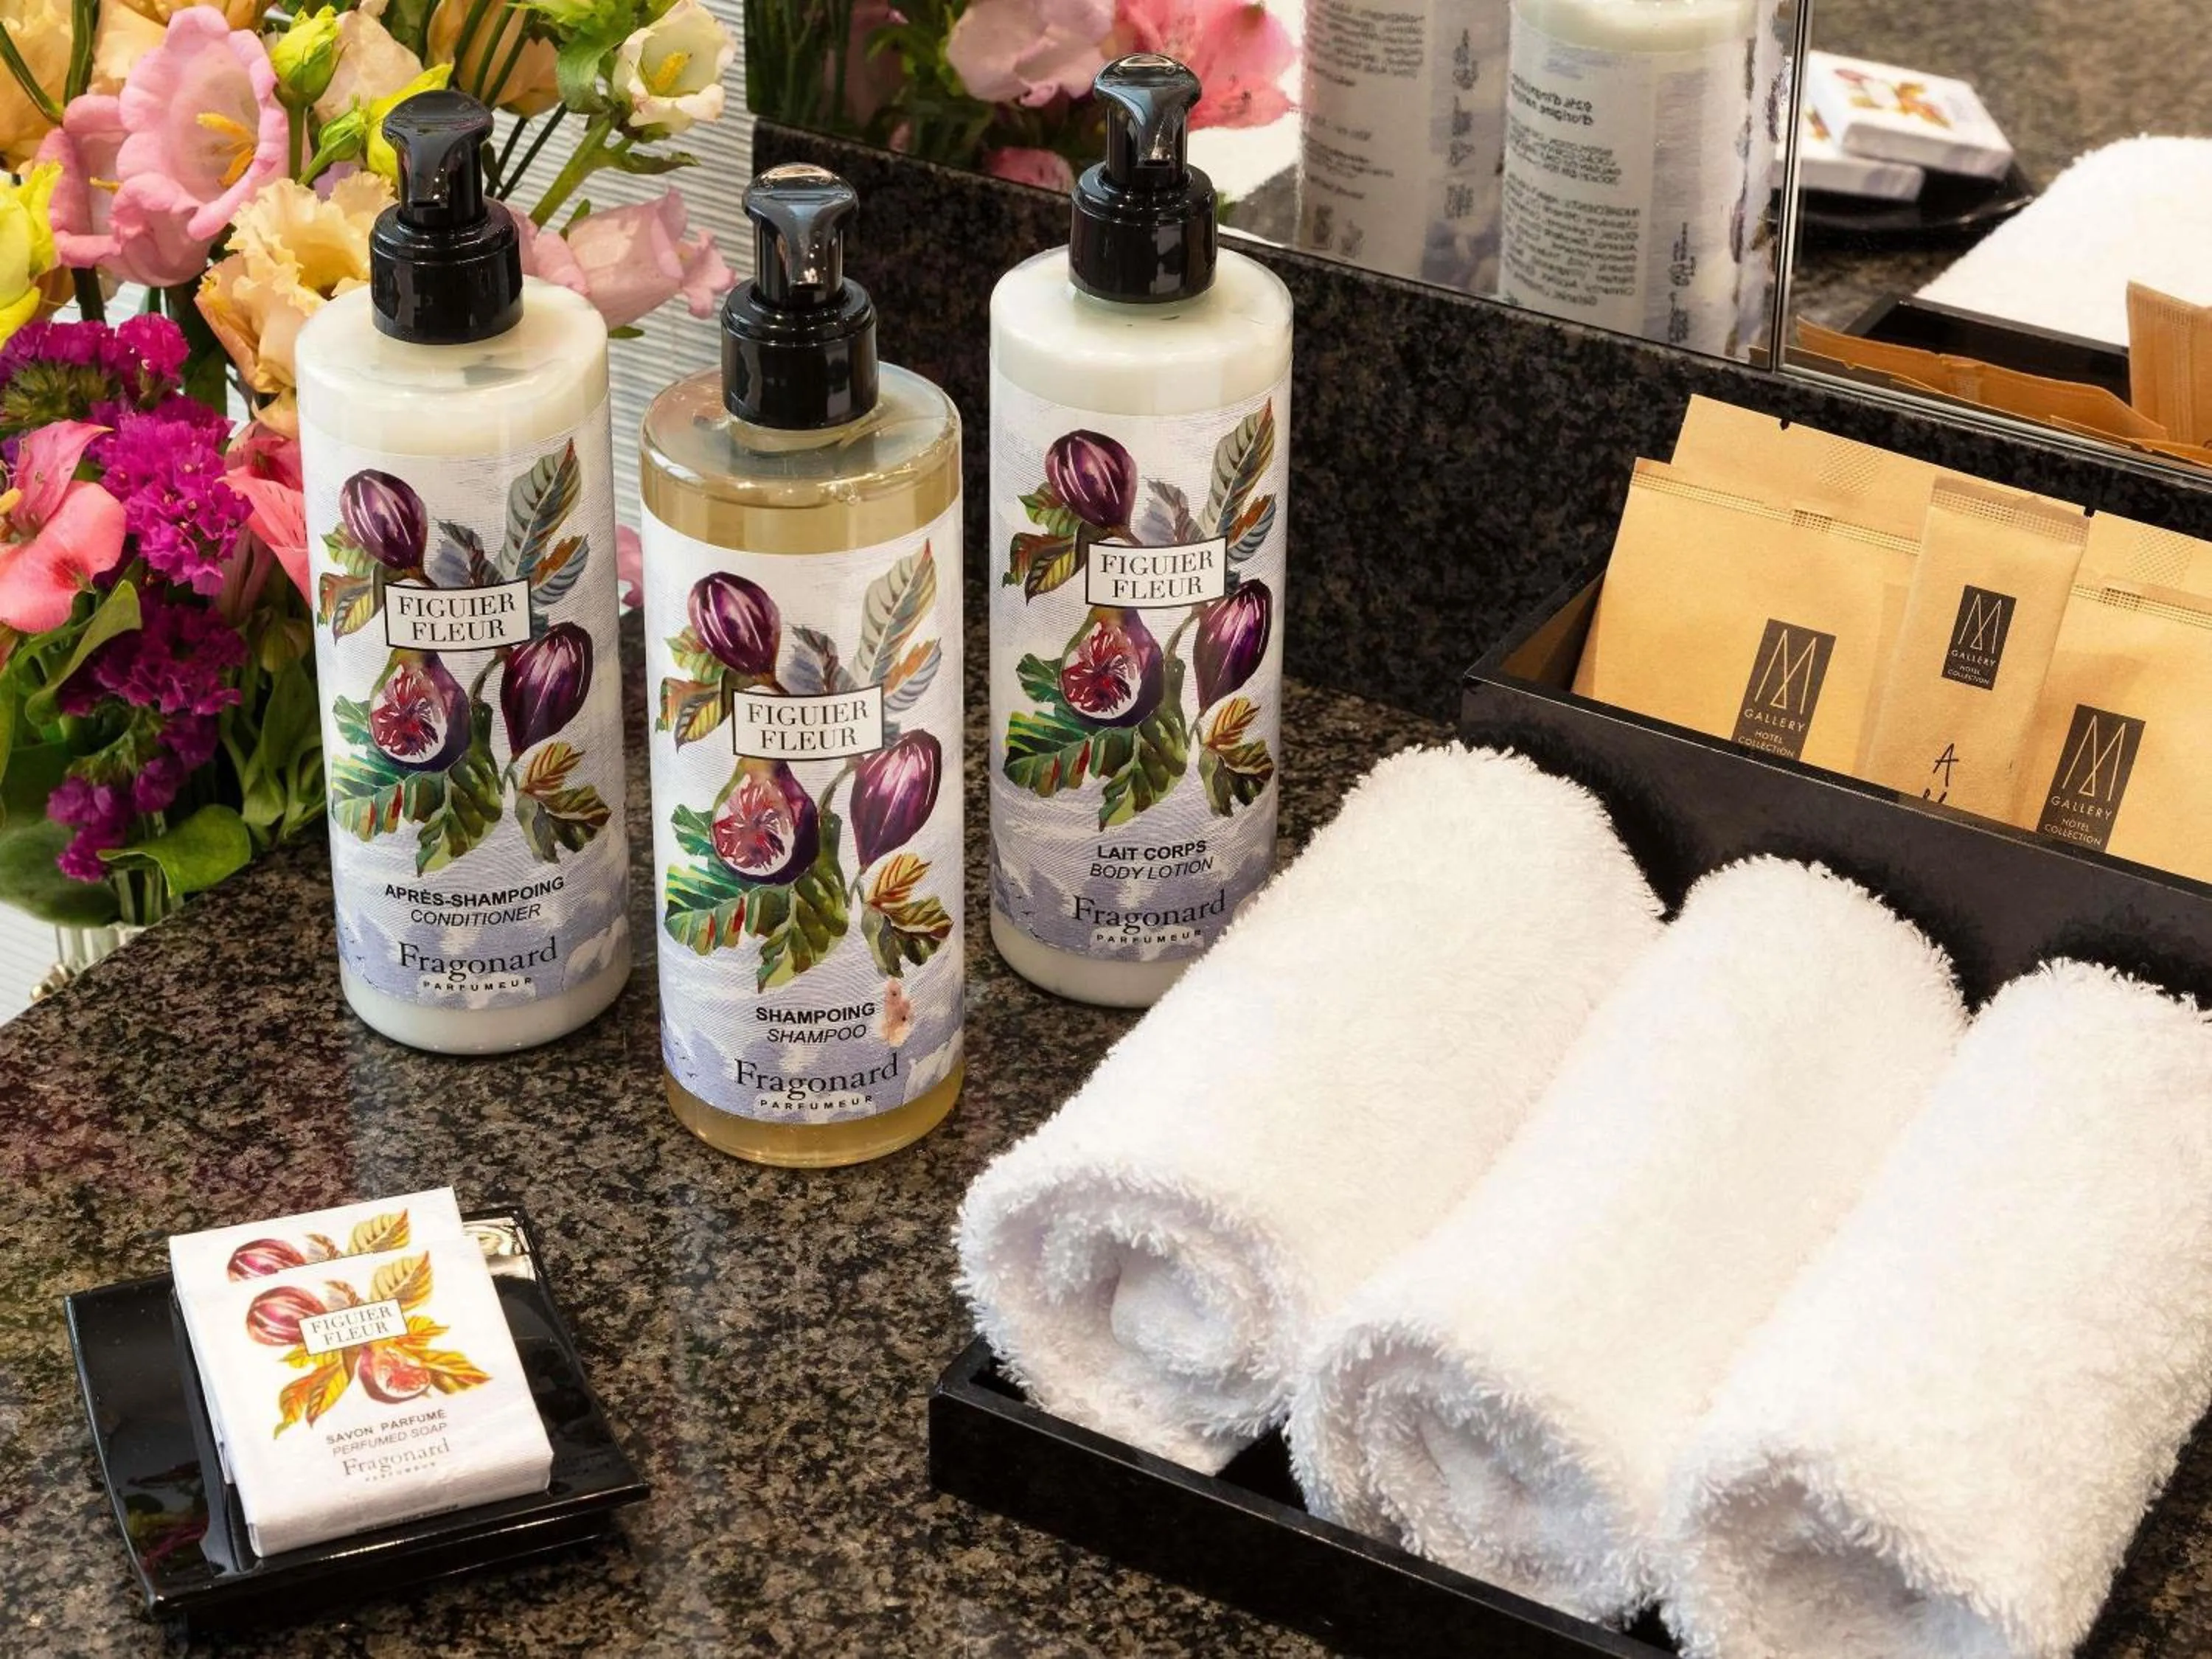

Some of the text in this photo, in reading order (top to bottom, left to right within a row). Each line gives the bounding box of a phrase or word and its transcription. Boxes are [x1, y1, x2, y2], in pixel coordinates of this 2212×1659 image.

[1100, 550, 1214, 576] FIGUIER
[1112, 576, 1203, 599] FLEUR
[398, 592, 515, 618] FIGUIER
[411, 619, 506, 641] FLEUR
[1951, 650, 1996, 667] GALLERY
[1947, 669, 1990, 685] COLLECTION
[747, 700, 869, 726] FIGUIER
[1744, 709, 1806, 732] GALLERY
[761, 726, 858, 751] FLEUR
[1738, 736, 1795, 758] COLLECTION
[1755, 731, 1784, 744] HOTEL
[2051, 796, 2112, 820] GALLERY
[2044, 824, 2102, 846] COLLECTION
[2062, 818, 2090, 832] HOTEL
[1097, 840, 1207, 860] LAIT CORPS
[1090, 856, 1214, 880] BODY LOTION
[385, 876, 564, 907] APRÈS-SHAMPOING
[411, 903, 540, 927] CONDITIONER
[1073, 888, 1225, 935] Fragonard
[1096, 930, 1202, 944] PARFUMEUR
[398, 935, 557, 982] Fragonard
[422, 977, 532, 992] PARFUMEUR
[756, 1002, 875, 1024] SHAMPOING
[767, 1024, 866, 1044] SHAMPOO
[734, 1052, 898, 1101] Fragonard
[760, 1095, 873, 1110] PARFUMEUR
[310, 1306, 393, 1334] FIGUIER
[322, 1321, 390, 1346] FLEUR
[325, 1427, 375, 1444] SAVON
[332, 1422, 448, 1457] PERFUMED SOAP
[342, 1437, 451, 1475] Fragonard
